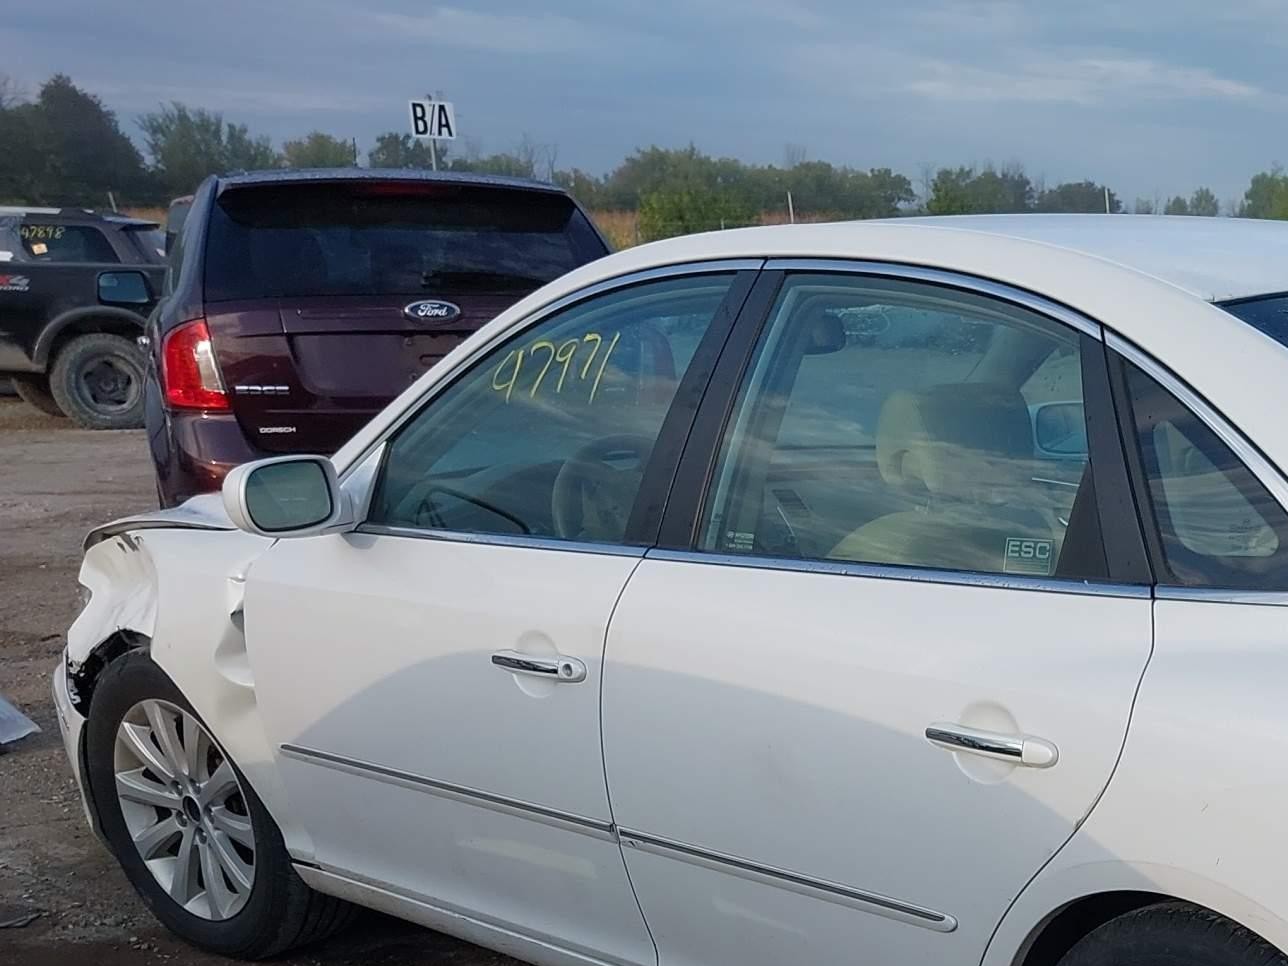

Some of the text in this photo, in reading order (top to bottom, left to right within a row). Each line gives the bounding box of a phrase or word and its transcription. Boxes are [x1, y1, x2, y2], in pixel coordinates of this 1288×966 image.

[411, 102, 453, 137] B/A
[417, 303, 448, 317] Ford
[1007, 541, 1050, 559] ESC
